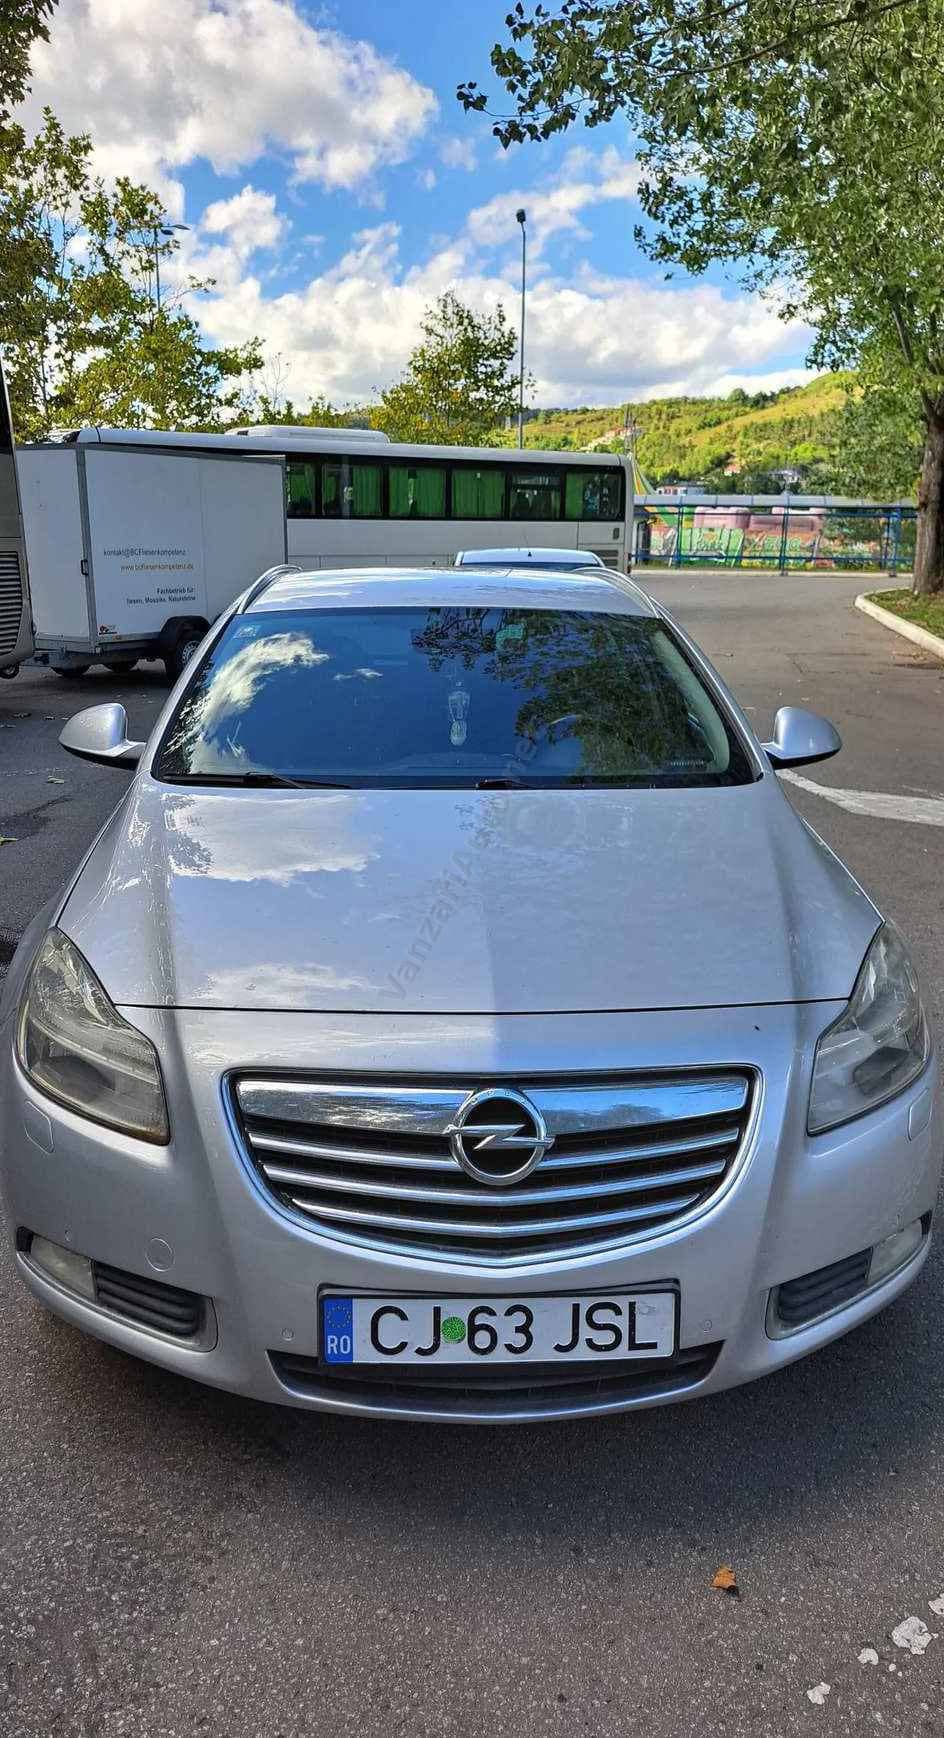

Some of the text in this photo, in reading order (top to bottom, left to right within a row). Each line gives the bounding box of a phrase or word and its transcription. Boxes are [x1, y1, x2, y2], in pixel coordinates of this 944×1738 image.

[326, 1335, 351, 1355] RO
[370, 1300, 658, 1356] CJ 63 JSL
